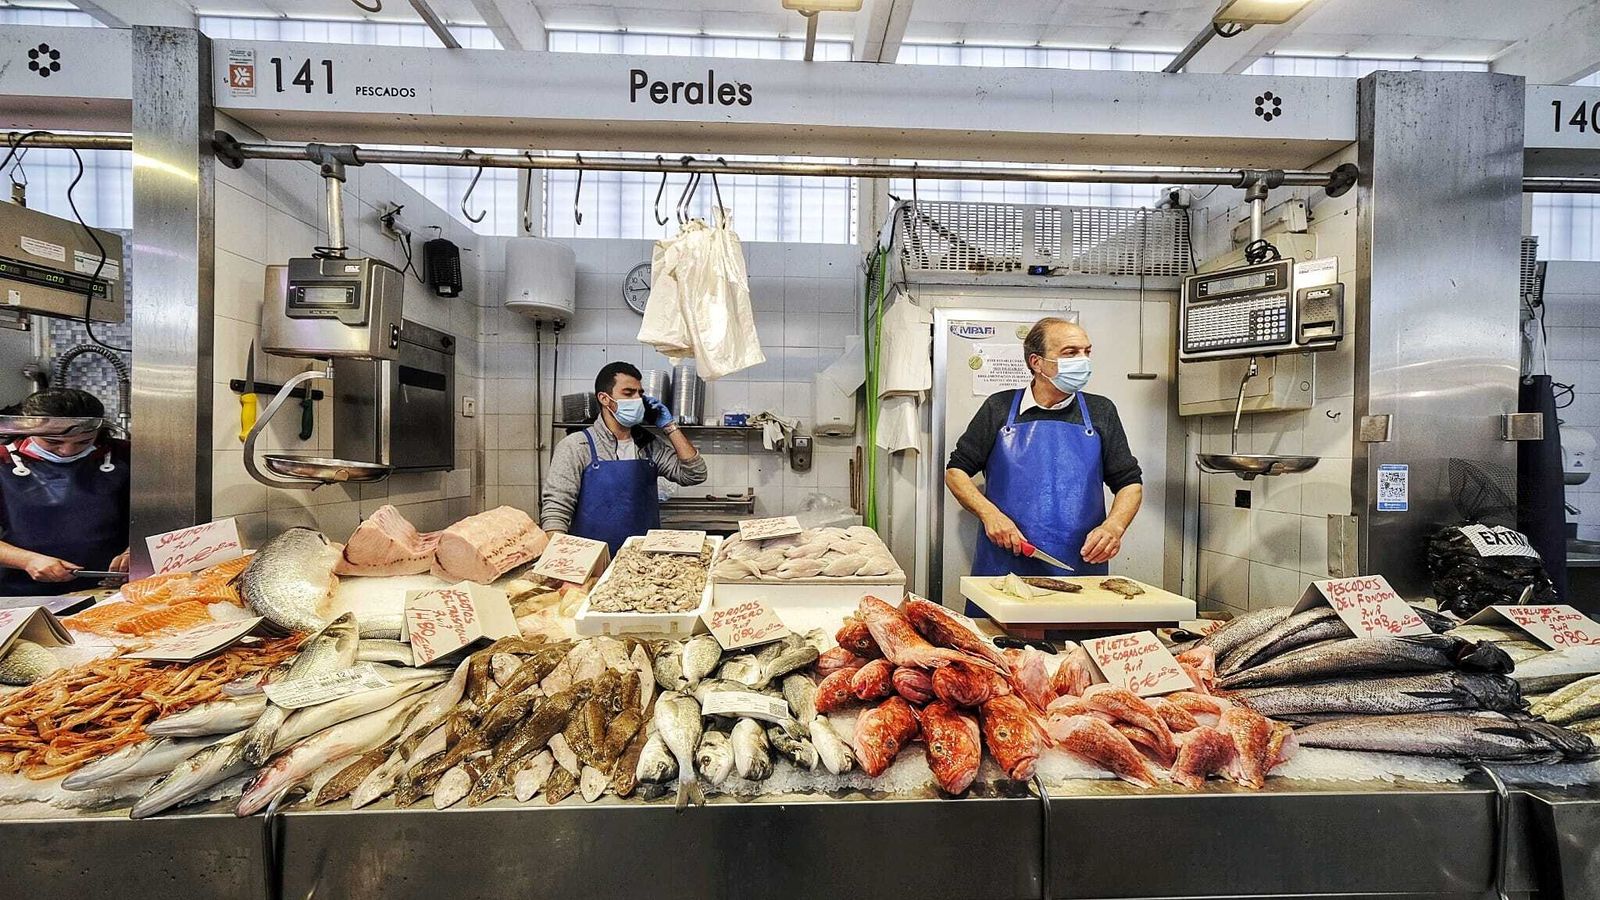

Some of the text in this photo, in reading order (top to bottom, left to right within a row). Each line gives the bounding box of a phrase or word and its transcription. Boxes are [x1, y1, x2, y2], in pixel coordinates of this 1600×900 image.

[271, 57, 334, 94] 141
[355, 86, 416, 98] PESCADOS
[630, 69, 753, 106] Perales
